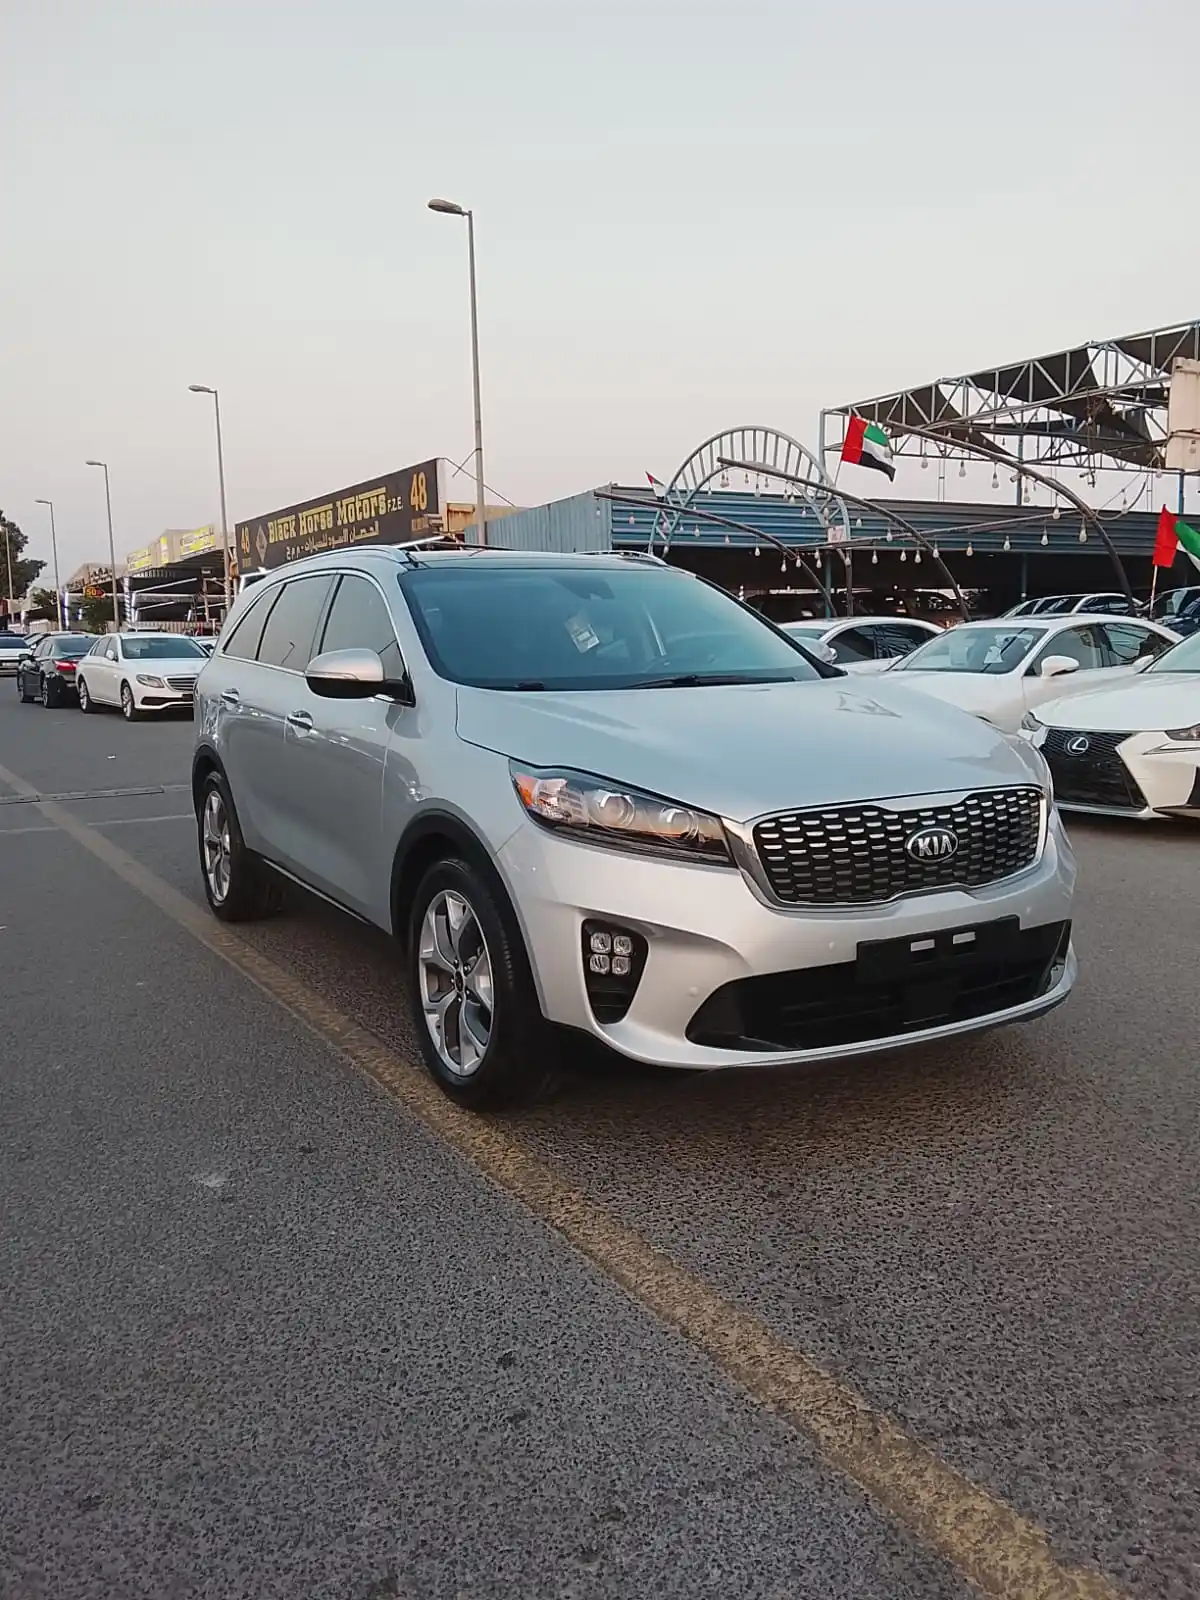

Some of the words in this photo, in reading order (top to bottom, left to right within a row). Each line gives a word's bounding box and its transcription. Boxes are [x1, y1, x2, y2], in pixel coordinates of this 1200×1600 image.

[411, 471, 427, 511] 48
[268, 514, 296, 544] Black
[299, 503, 333, 536] Horse
[336, 486, 386, 525] Motors
[241, 526, 250, 554] 48
[917, 834, 952, 857] KIA
